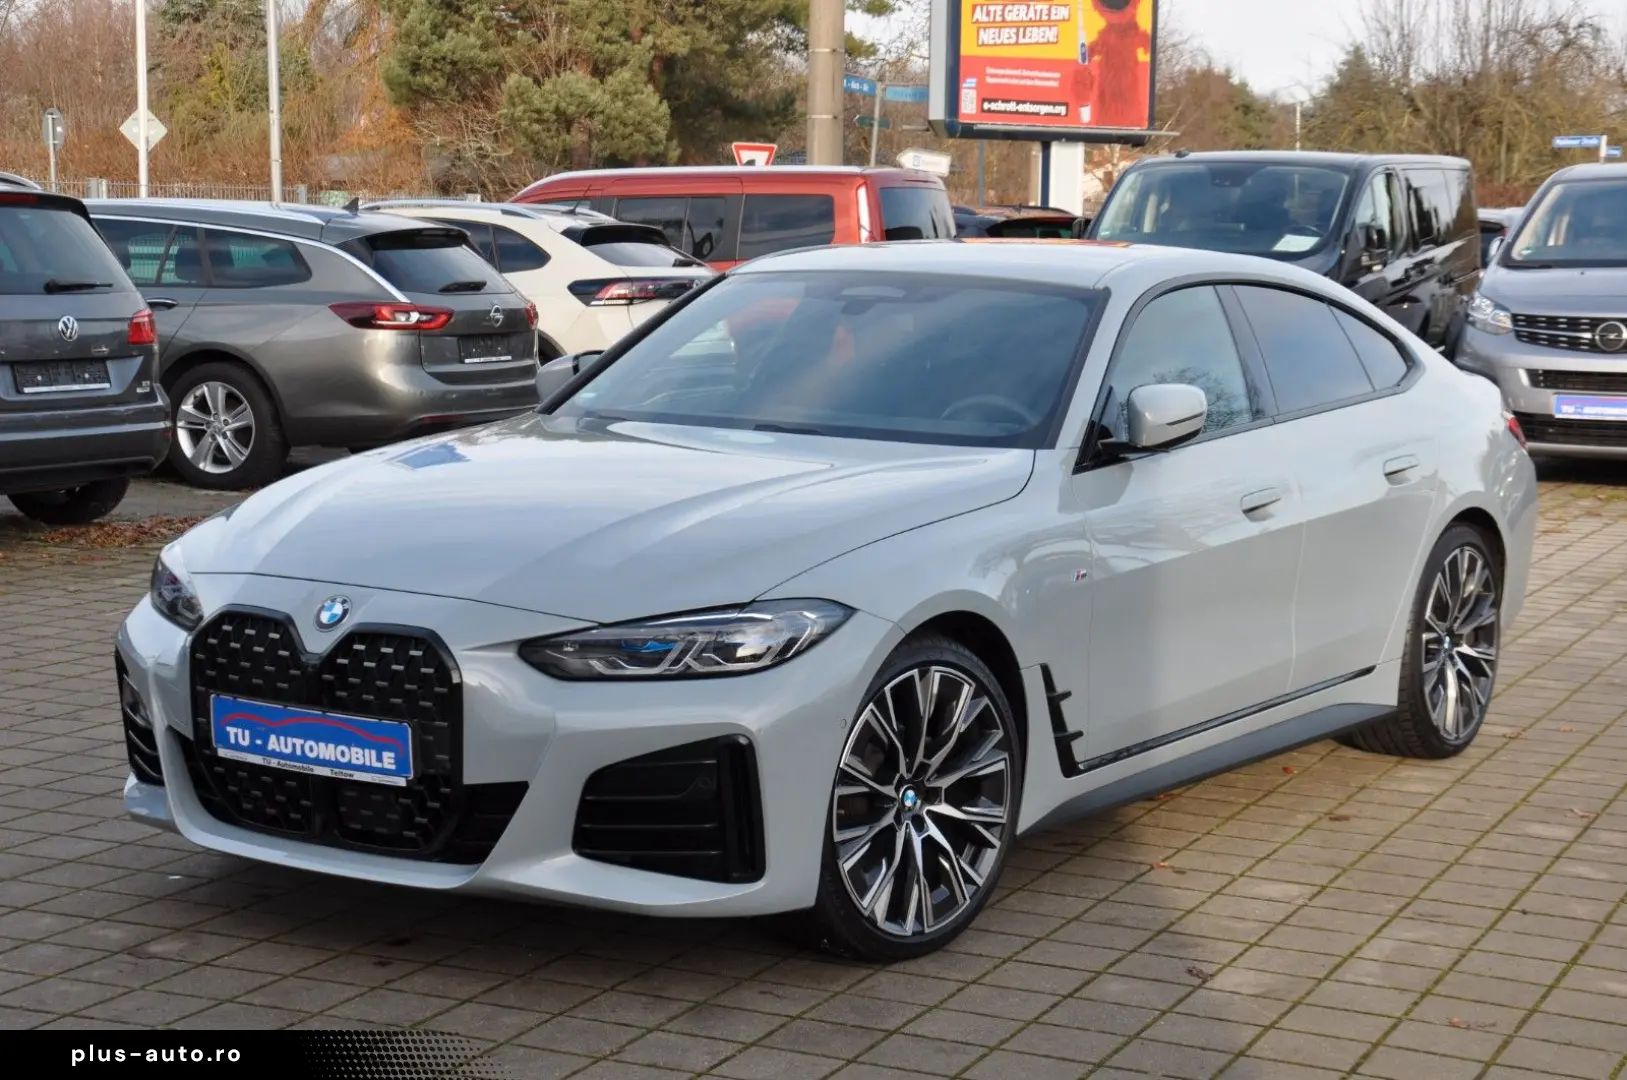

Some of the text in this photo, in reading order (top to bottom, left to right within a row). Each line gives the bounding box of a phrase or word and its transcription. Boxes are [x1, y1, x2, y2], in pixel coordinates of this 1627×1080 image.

[972, 2, 1070, 22] ALTE GERÄTE EIN
[978, 26, 1058, 45] NEUES LEBEN!
[983, 100, 1067, 116] e-schrott-entsorgen.org
[226, 726, 250, 746] TU
[267, 734, 397, 769] AUTOMOBILE
[276, 761, 314, 773] Automobile
[329, 769, 355, 778] Teltow
